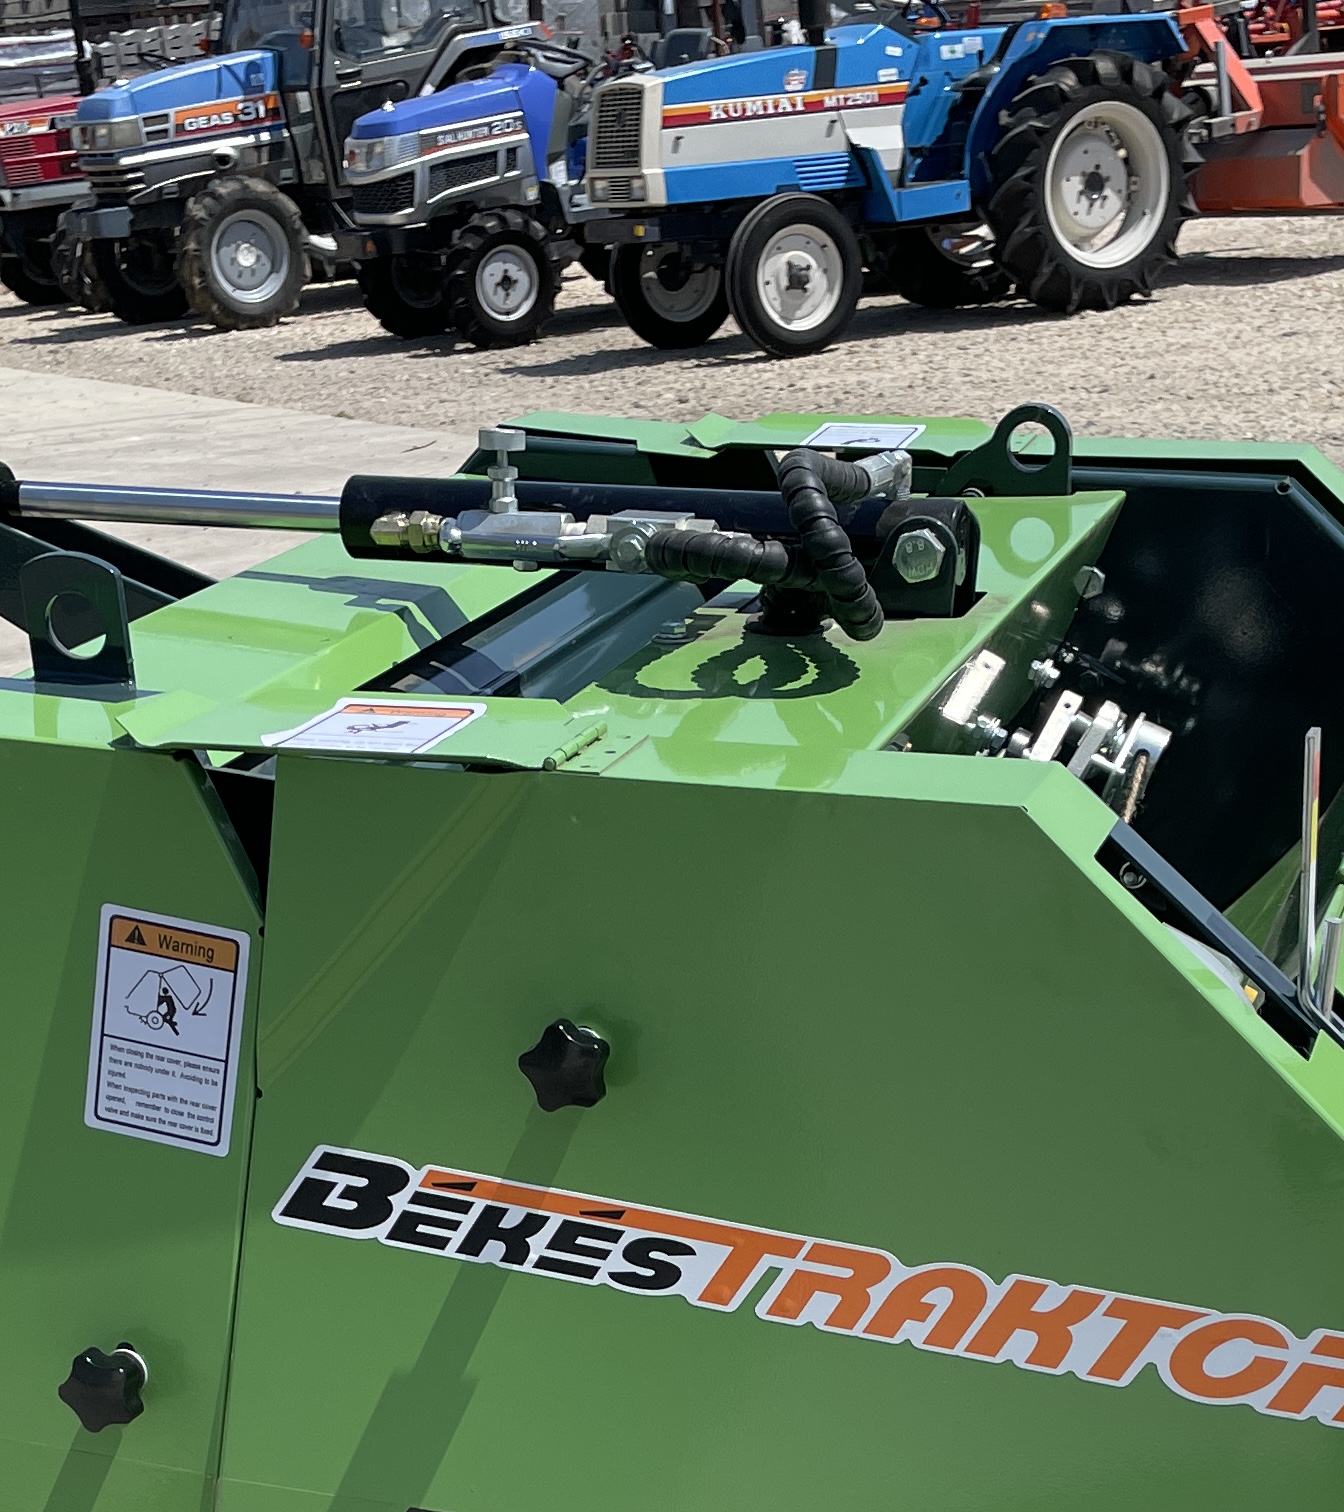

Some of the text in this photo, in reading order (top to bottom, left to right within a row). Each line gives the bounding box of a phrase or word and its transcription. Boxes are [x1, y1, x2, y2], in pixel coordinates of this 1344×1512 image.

[184, 100, 267, 131] GEAS 31
[710, 96, 805, 120] KUMIAI
[158, 933, 215, 963] Warning
[145, 1052, 154, 1060] the
